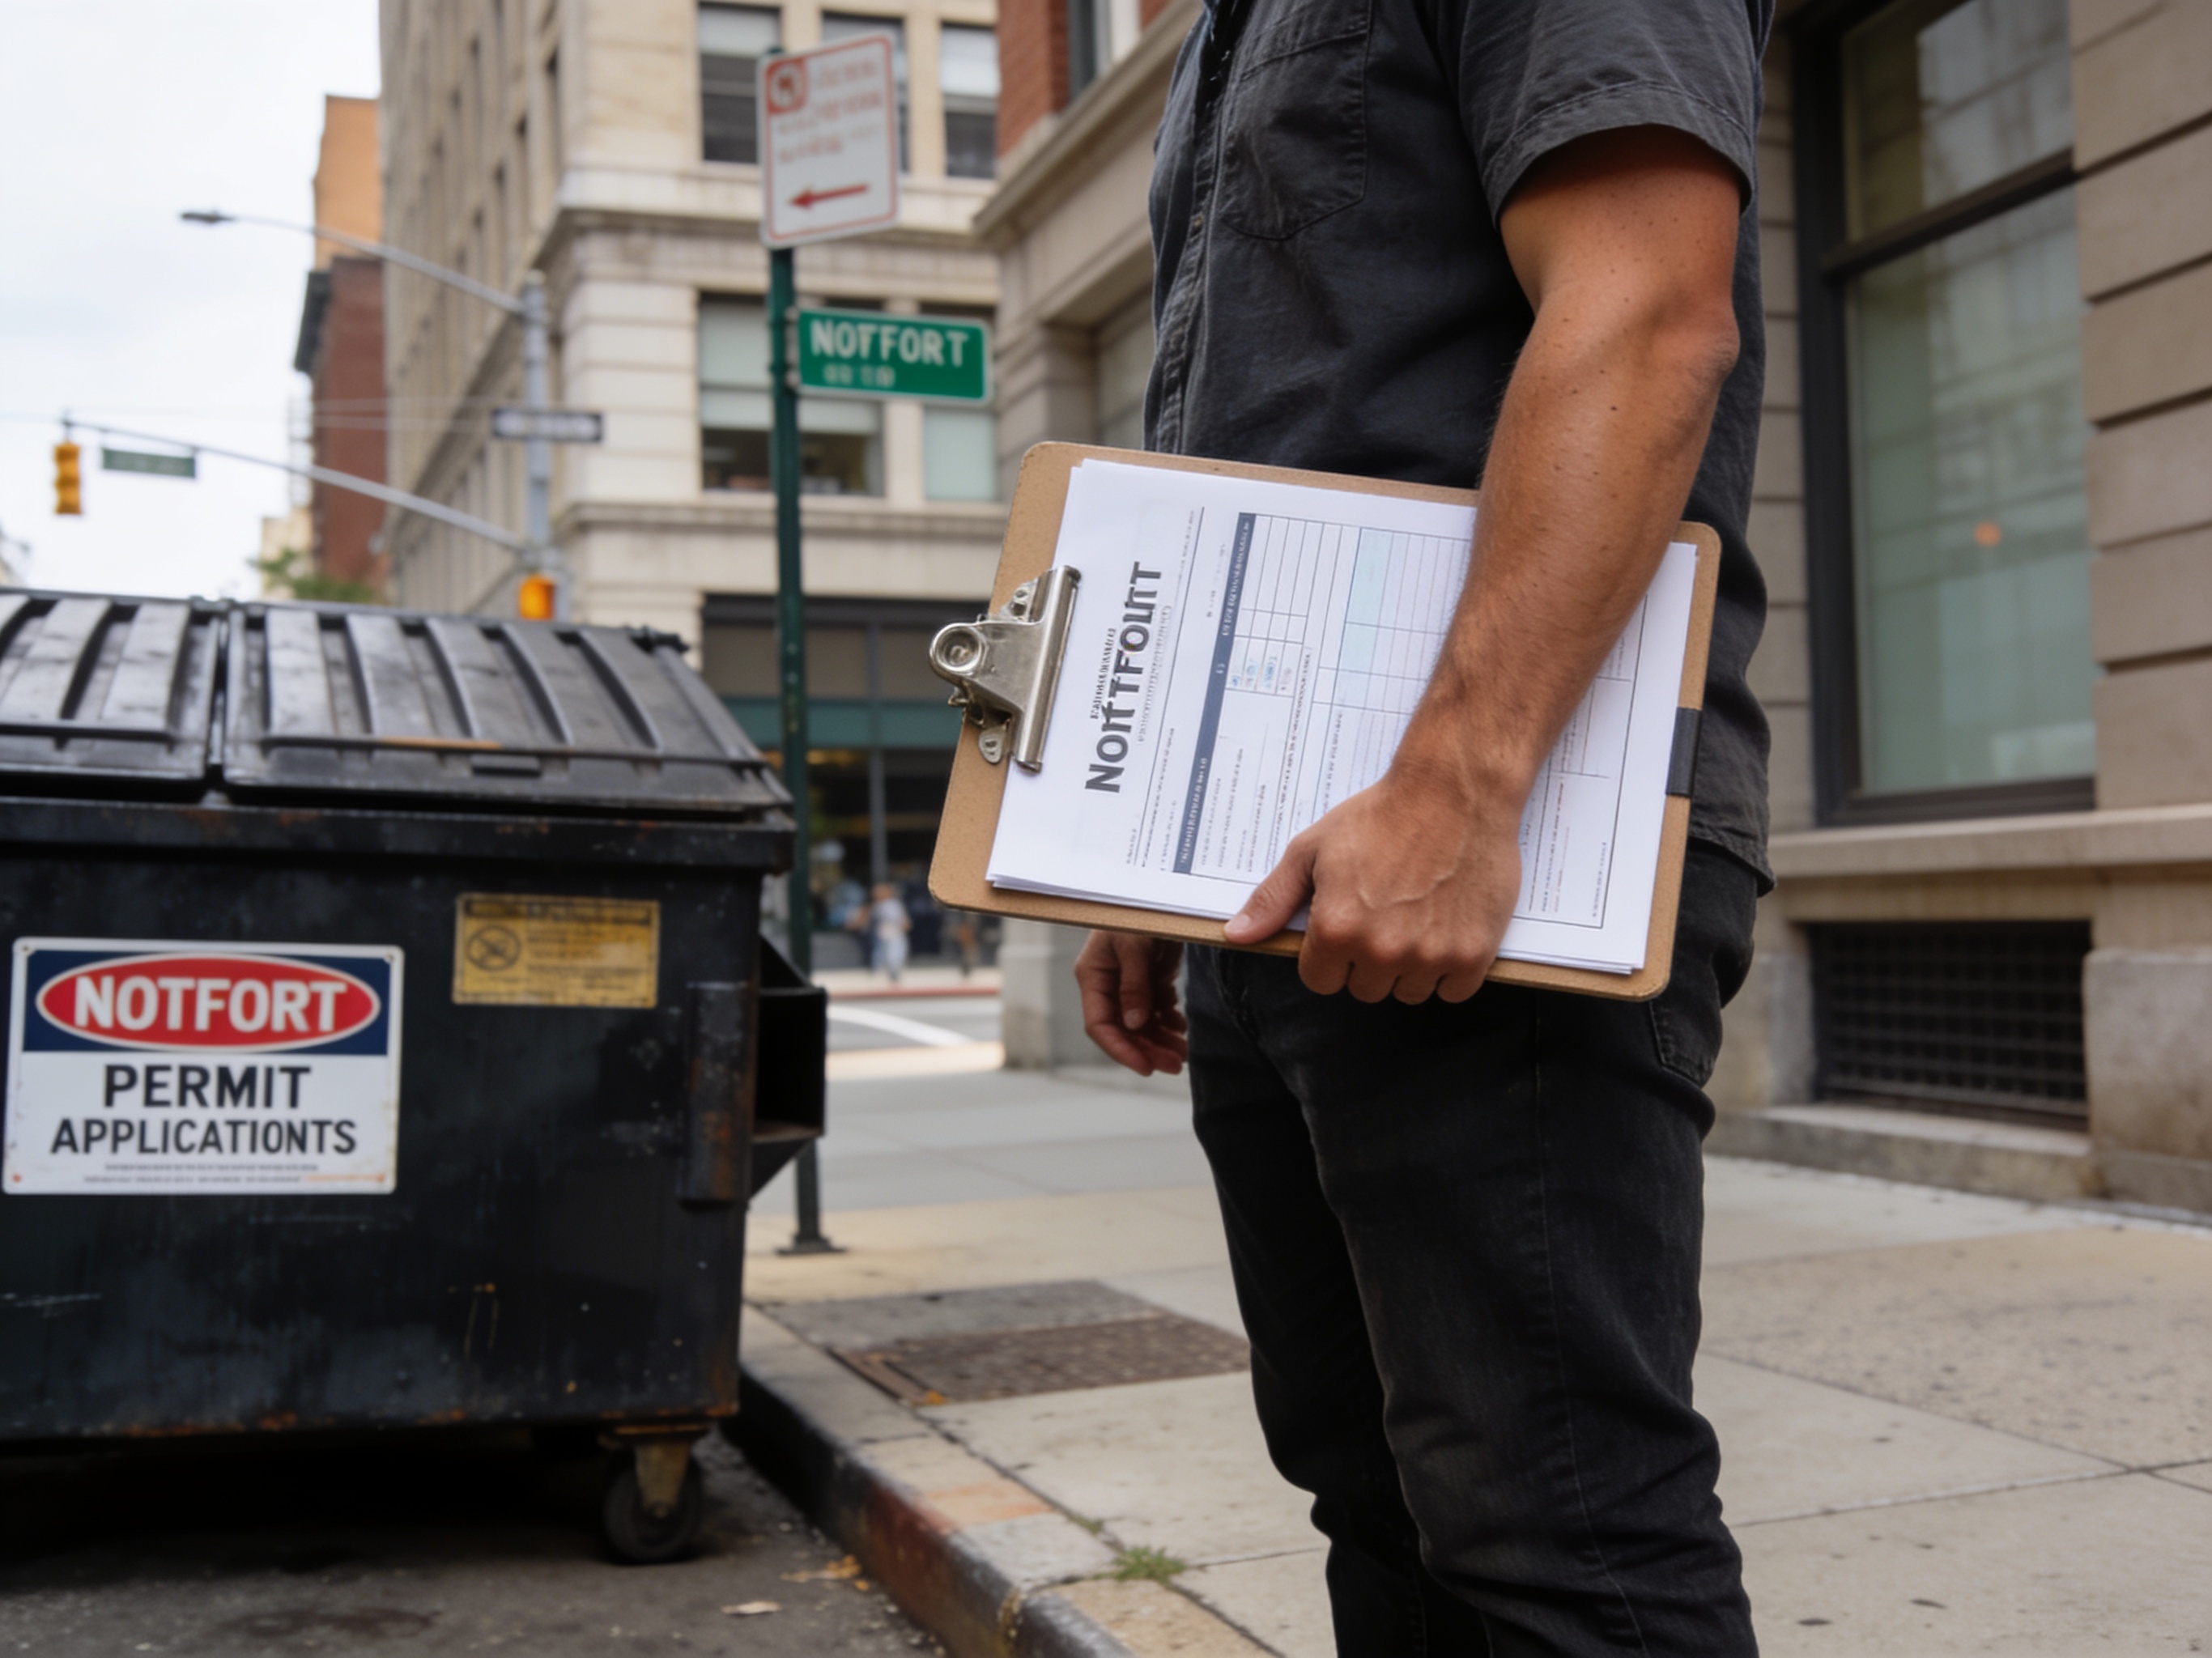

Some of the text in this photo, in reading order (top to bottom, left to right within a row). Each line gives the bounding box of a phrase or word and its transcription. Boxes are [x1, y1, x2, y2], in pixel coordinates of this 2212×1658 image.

[810, 318, 969, 368] NOTFORT
[74, 975, 347, 1033] NOTFORT
[104, 1064, 312, 1109] PERMIT
[49, 1118, 357, 1155] APPLICATIONTS
